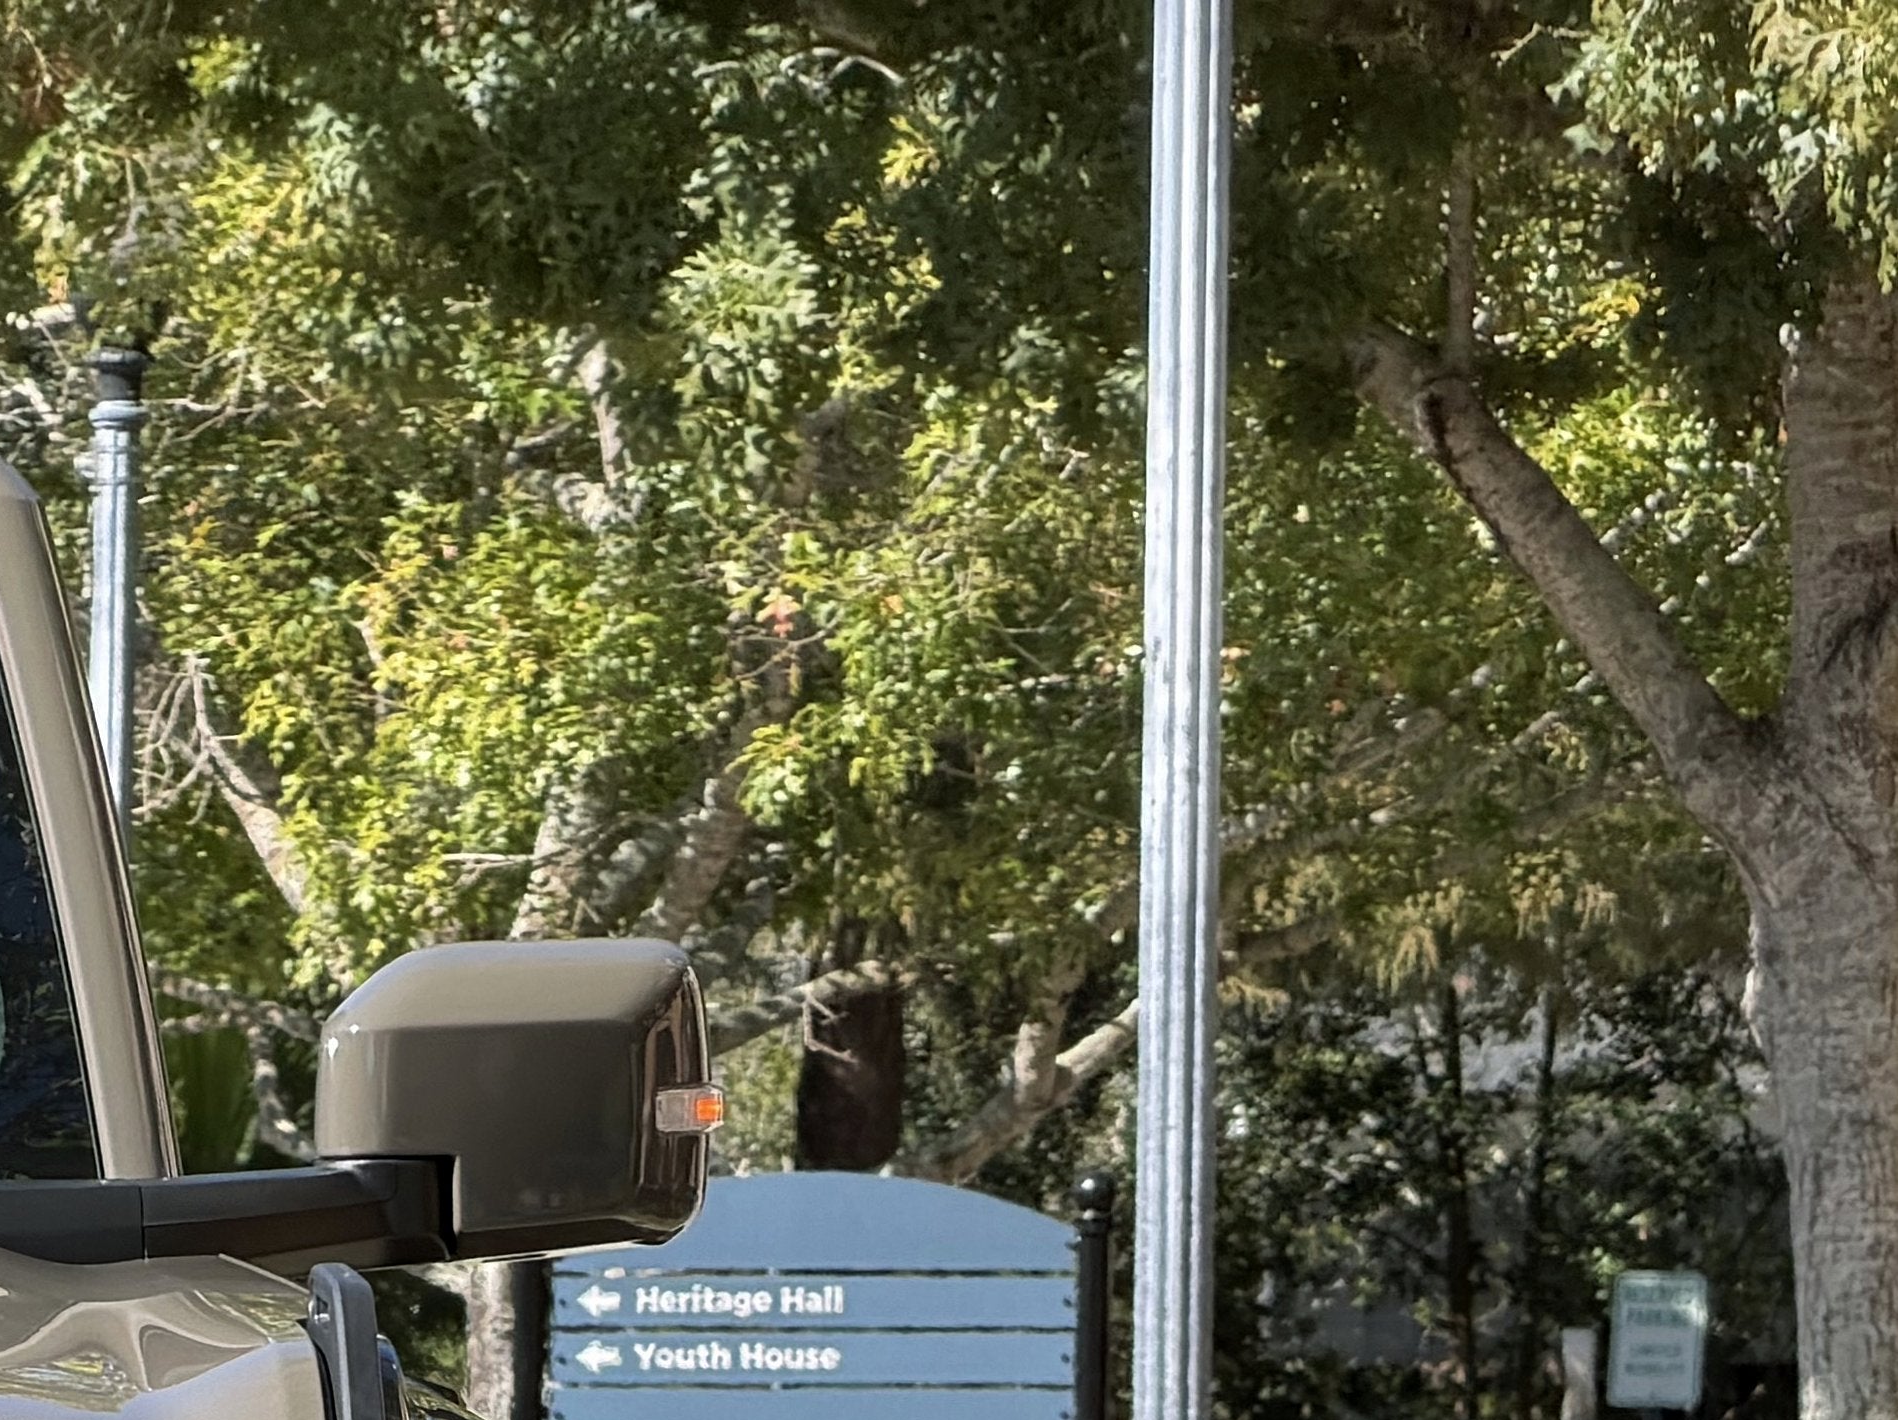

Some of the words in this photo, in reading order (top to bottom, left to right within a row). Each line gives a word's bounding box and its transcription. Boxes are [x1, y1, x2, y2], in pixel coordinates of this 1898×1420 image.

[635, 1282, 773, 1318] Heritage
[779, 1284, 844, 1314] Hall
[633, 1340, 732, 1370] Youth
[739, 1341, 842, 1370] House
